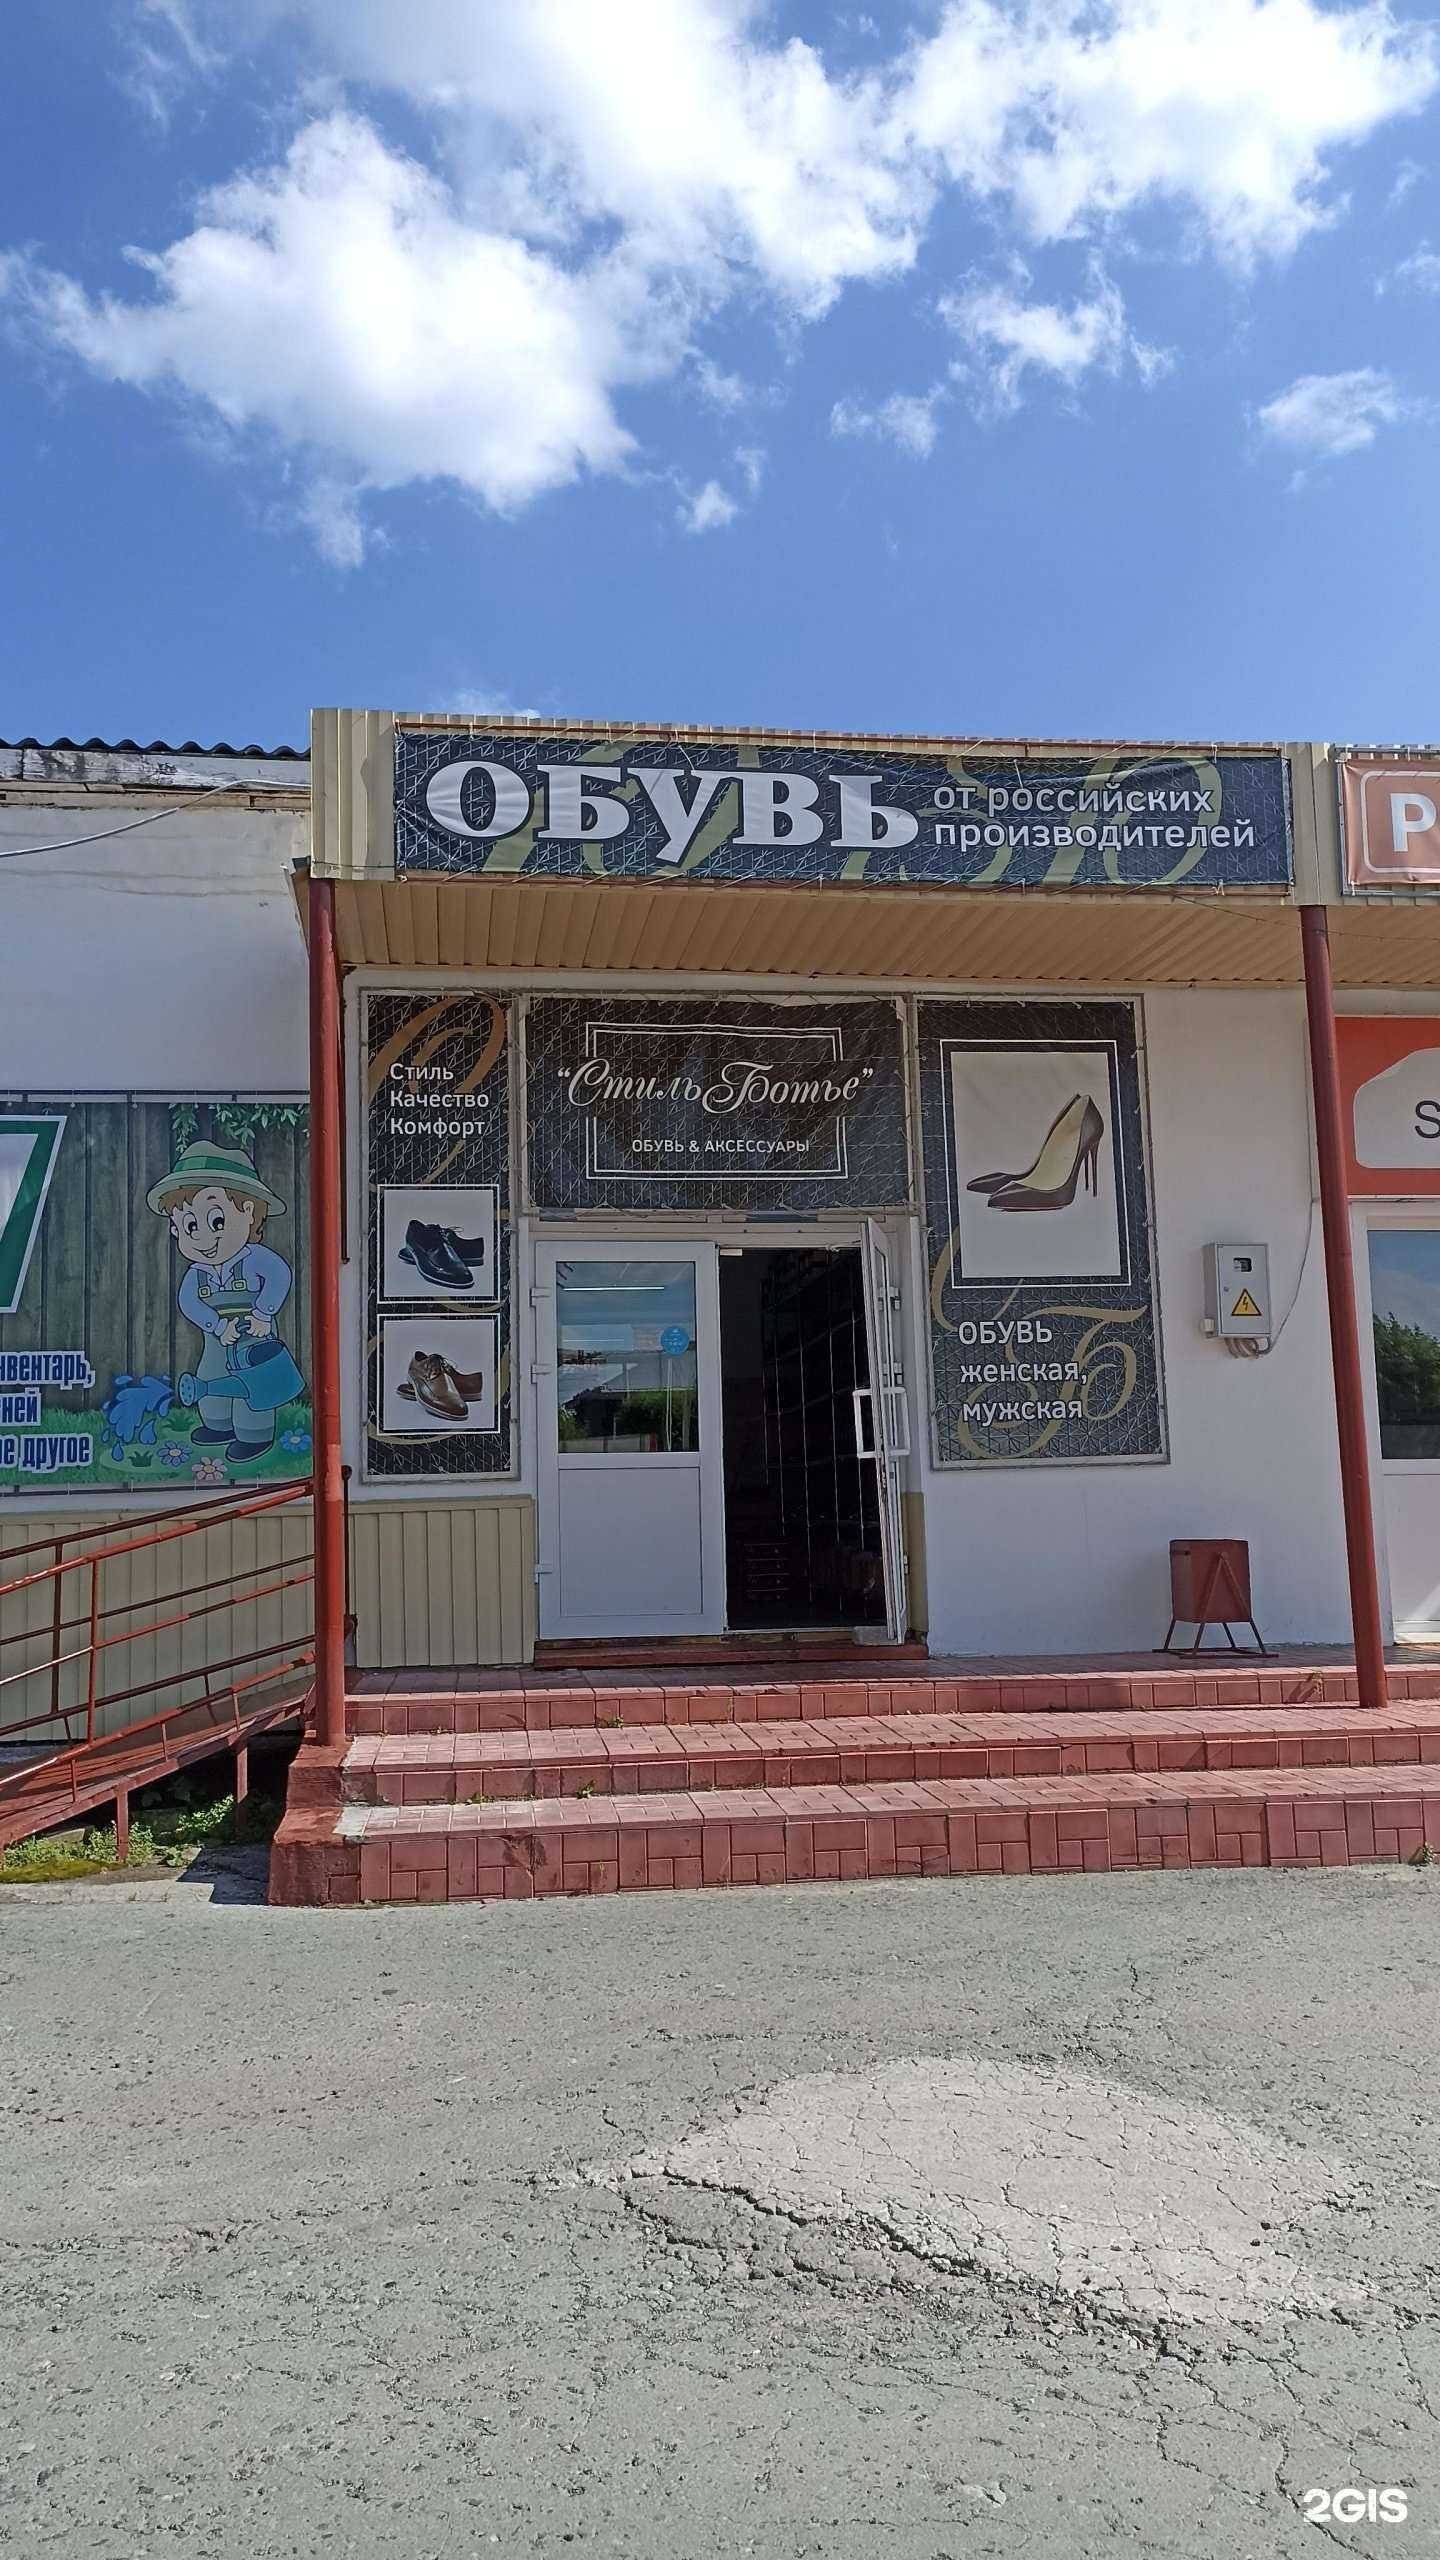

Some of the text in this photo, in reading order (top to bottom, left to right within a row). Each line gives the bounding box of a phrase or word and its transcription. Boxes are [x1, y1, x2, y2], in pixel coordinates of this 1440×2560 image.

[933, 780, 1213, 817] от российских
[426, 760, 919, 865] ОБУВЬ
[934, 818, 1255, 853] производителей
[389, 1062, 454, 1082] Стиль
[389, 1089, 489, 1109] Качество
[389, 1116, 486, 1140] Комфорт
[631, 1139, 810, 1154] ОБУВЬ & АКСЕССУАРЫ
[958, 1320, 1053, 1345] ОБУВЬ
[959, 1363, 1088, 1385] женская,
[0, 1390, 38, 1423] ней
[961, 1401, 1084, 1426] мужская
[22, 1436, 90, 1470] другое
